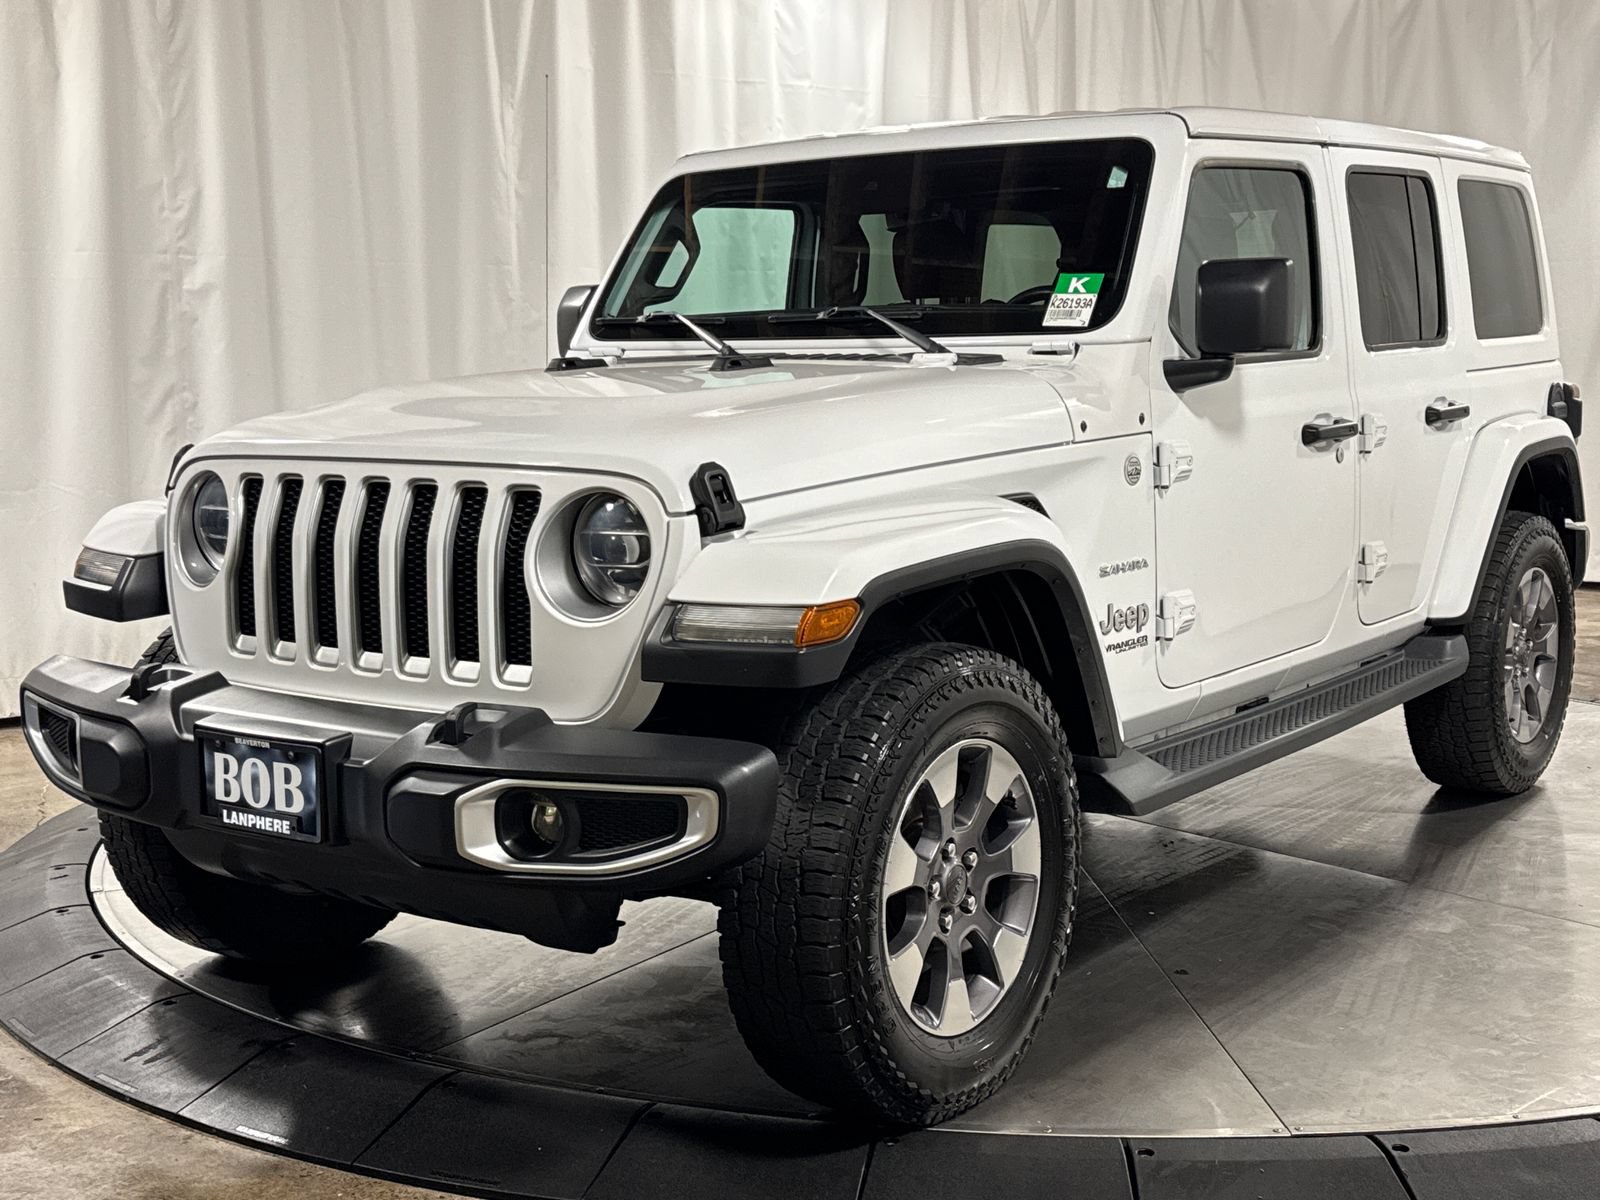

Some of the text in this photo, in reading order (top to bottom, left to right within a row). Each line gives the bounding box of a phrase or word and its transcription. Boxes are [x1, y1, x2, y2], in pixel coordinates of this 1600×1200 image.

[1067, 276, 1092, 293] K
[1050, 297, 1094, 309] K26193A
[1099, 558, 1150, 578] SAHARA
[1099, 602, 1150, 636] Jeep
[1104, 634, 1149, 653] WRANGLER
[213, 751, 305, 814] BOB
[222, 809, 291, 835] LANPHERE
